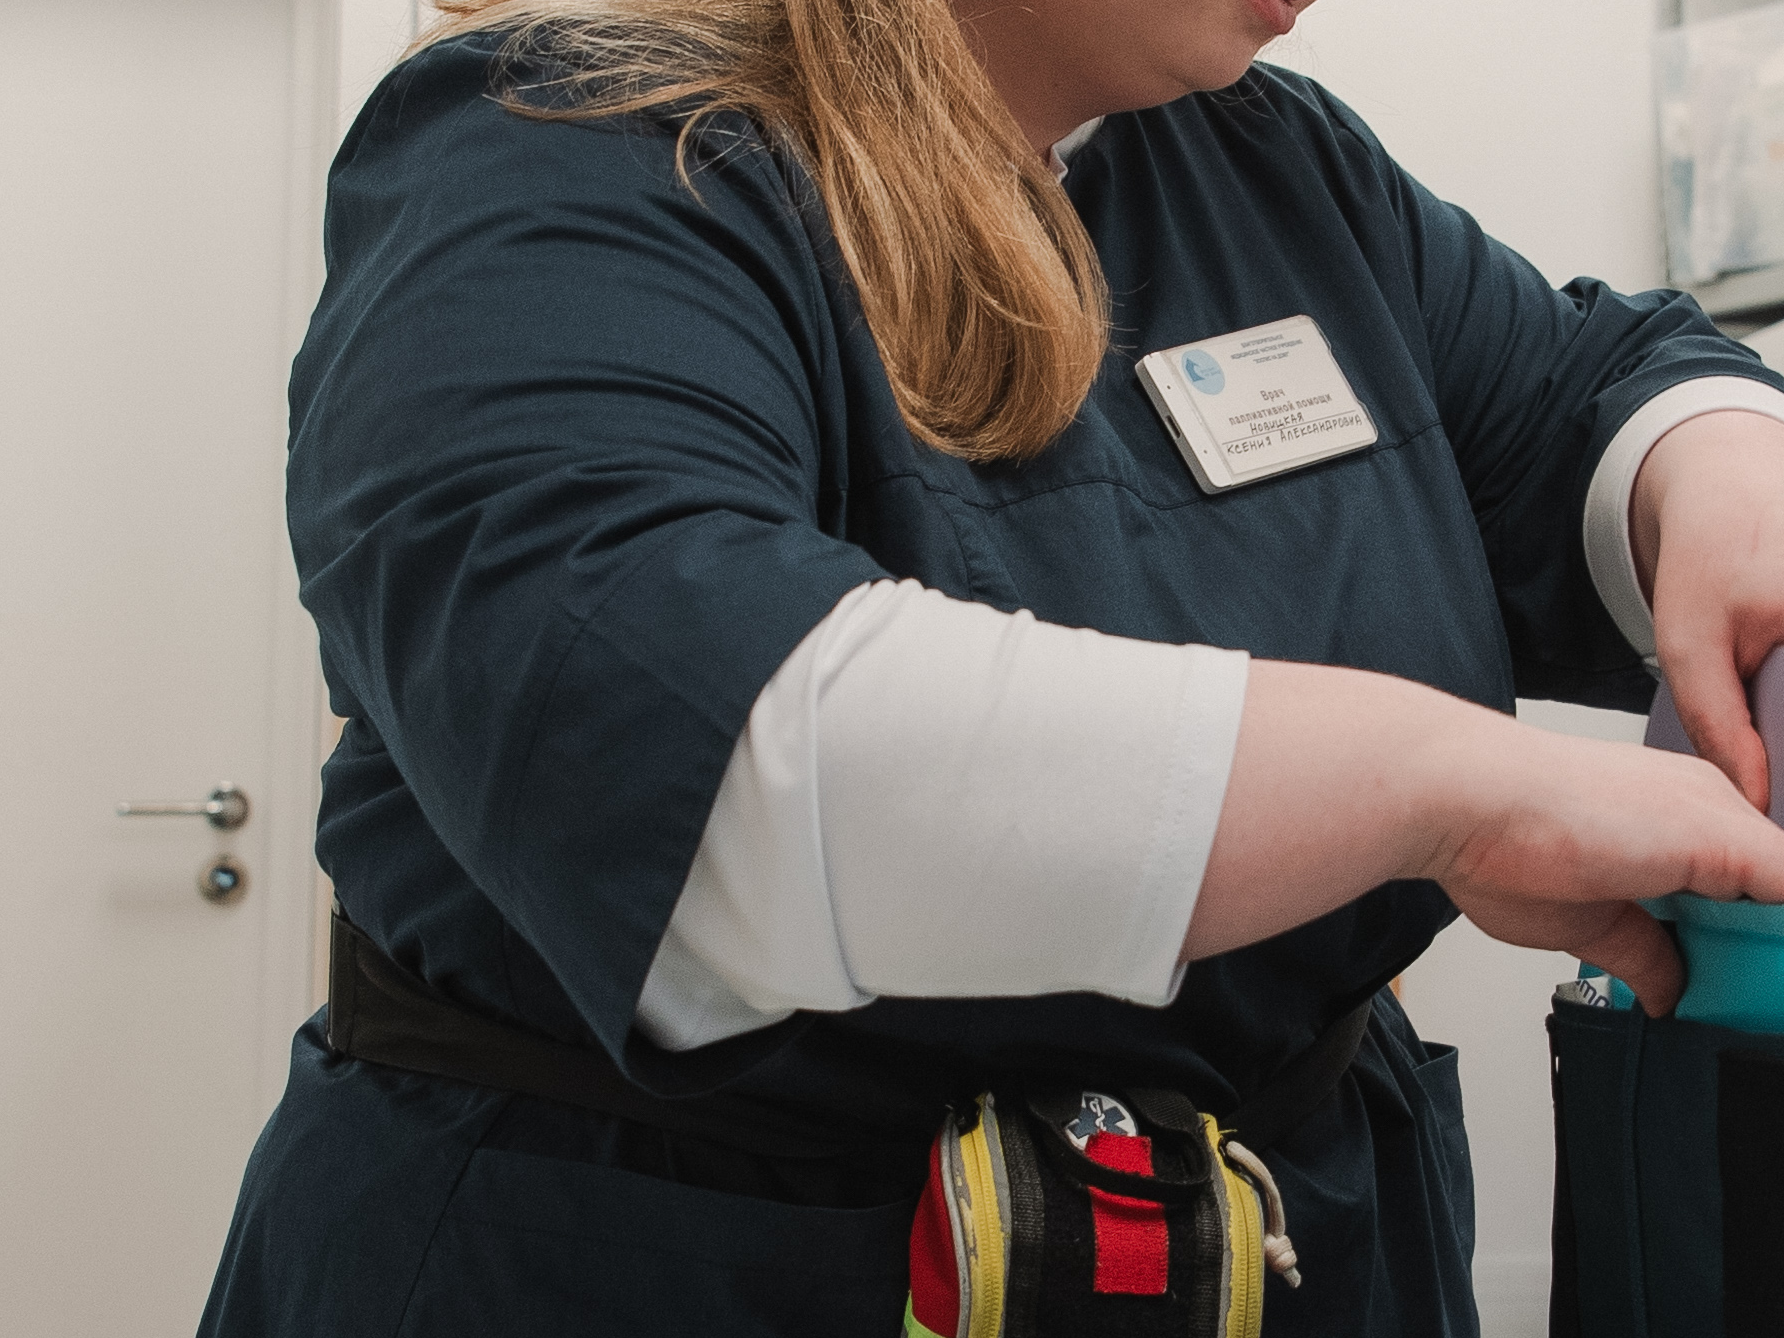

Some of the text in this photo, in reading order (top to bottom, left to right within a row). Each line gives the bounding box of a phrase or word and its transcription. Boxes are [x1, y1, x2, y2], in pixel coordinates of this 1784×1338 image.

[1260, 388, 1286, 402] Врач
[1228, 393, 1333, 426] паллиативной помощи
